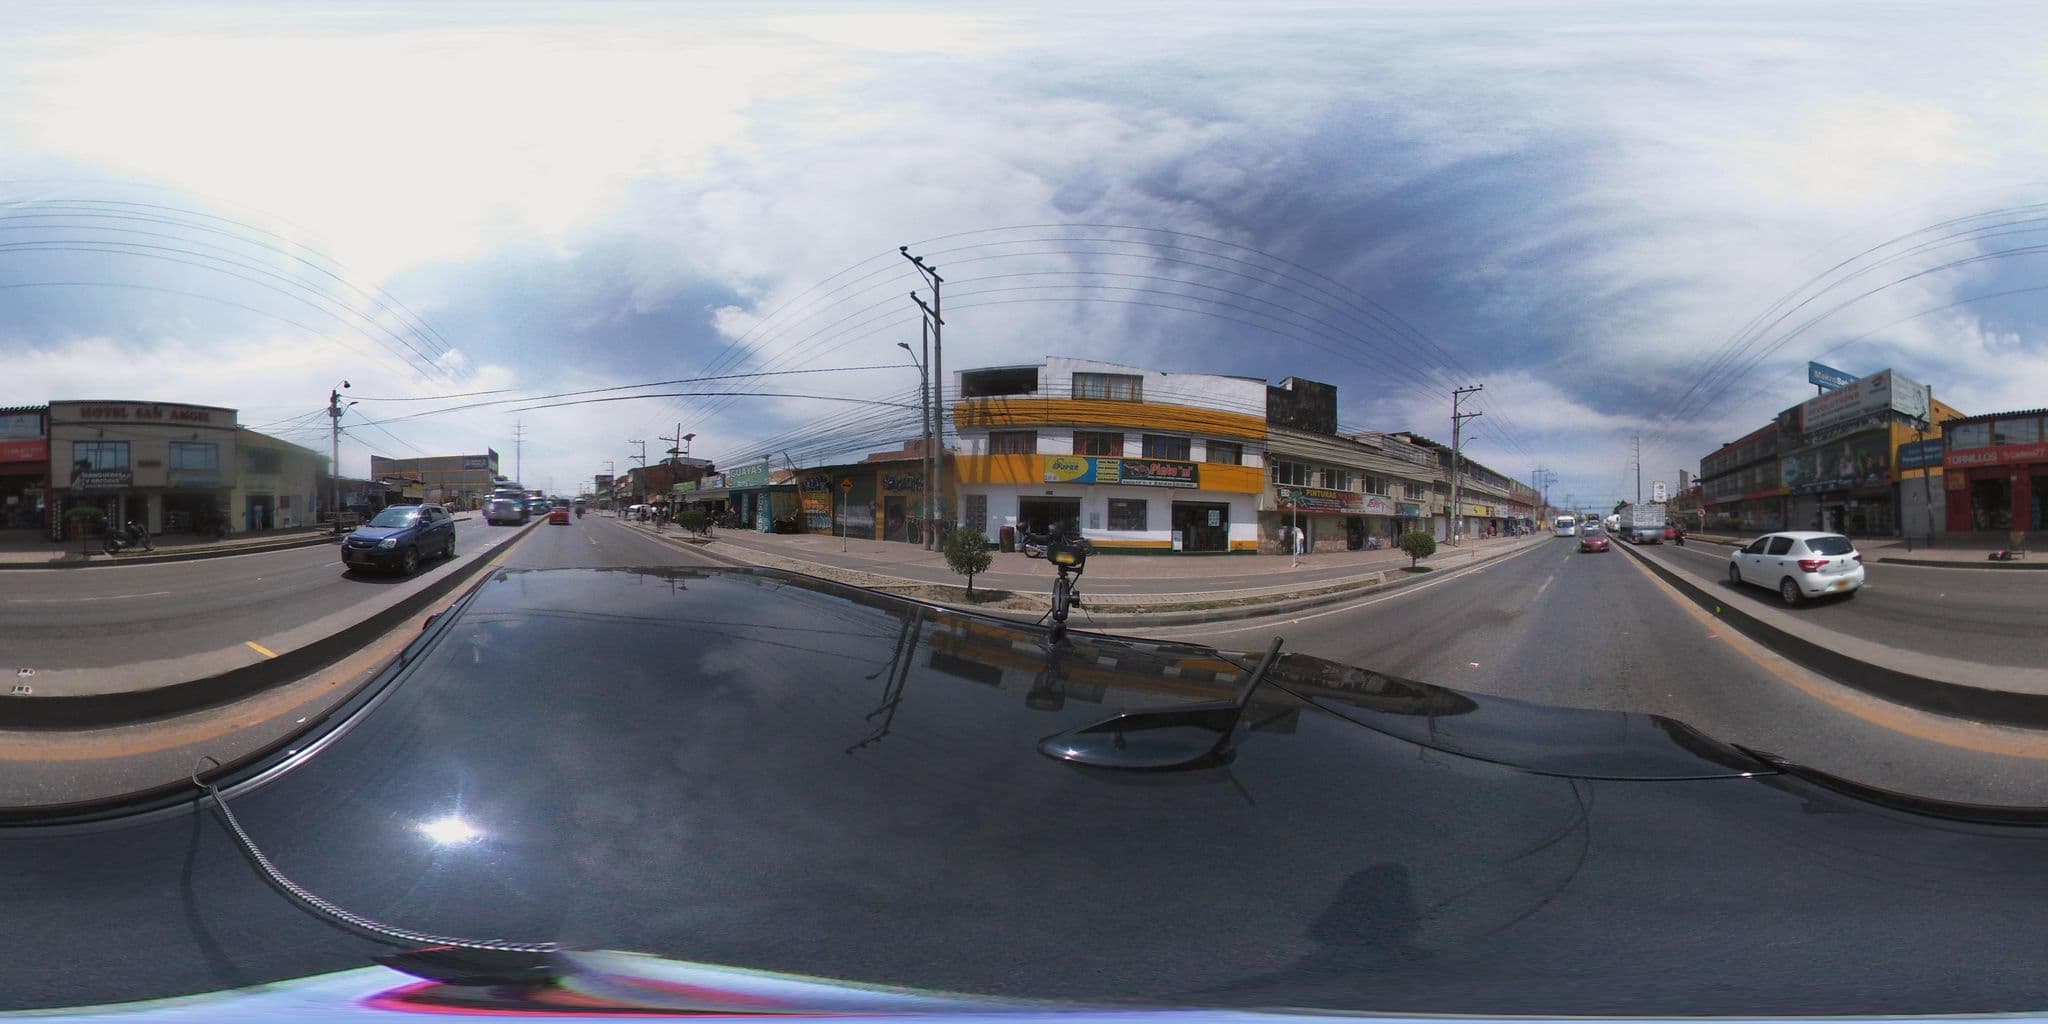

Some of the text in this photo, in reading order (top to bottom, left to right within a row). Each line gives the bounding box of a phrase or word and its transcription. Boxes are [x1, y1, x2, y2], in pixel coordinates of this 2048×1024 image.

[80, 405, 210, 421] HOTEL SAN ANGEL
[1947, 452, 1998, 465] TORNILLOS
[730, 465, 763, 478] GUAYAS
[1306, 489, 1337, 499] PINTURAS
